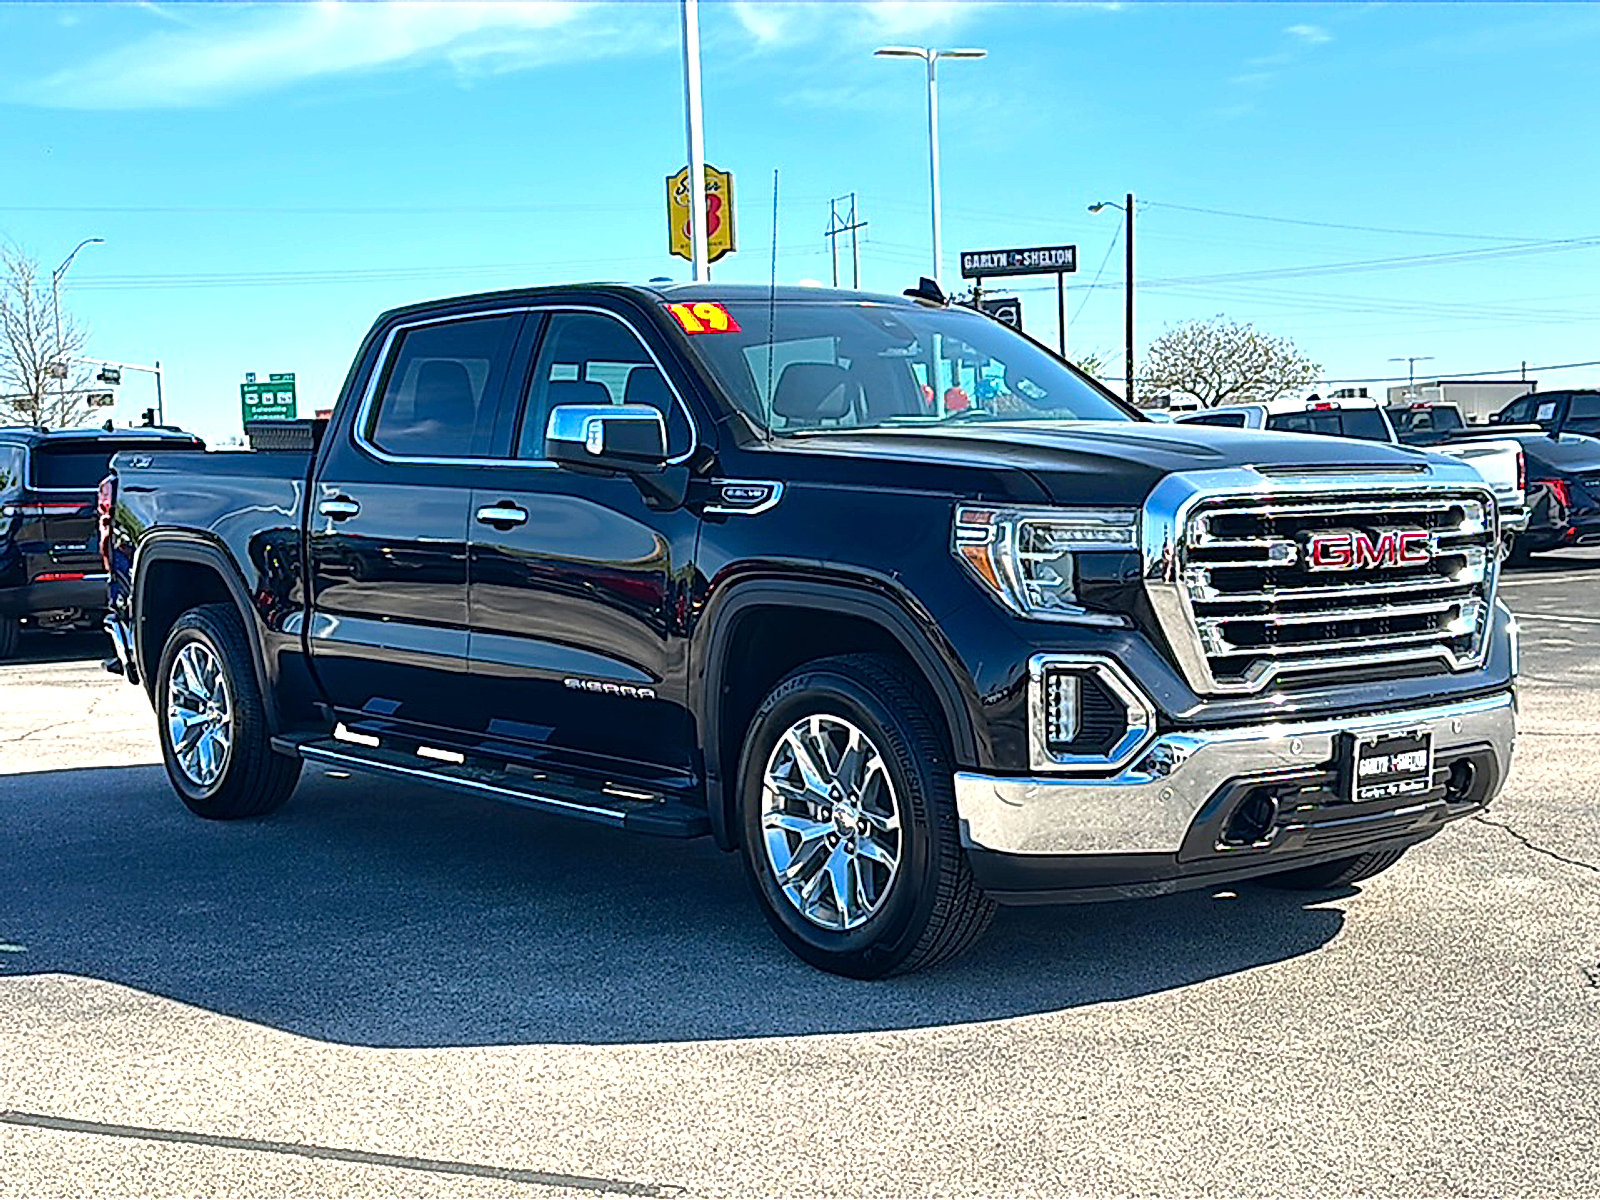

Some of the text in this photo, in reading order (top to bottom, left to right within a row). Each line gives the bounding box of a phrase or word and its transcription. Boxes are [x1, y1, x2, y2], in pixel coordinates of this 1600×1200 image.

[963, 248, 1073, 270] GARLYN SHELTON
[670, 302, 728, 332] 19
[1309, 531, 1429, 570] GMC
[563, 678, 656, 699] SIERRA
[880, 722, 927, 829] BRIDGESTONE
